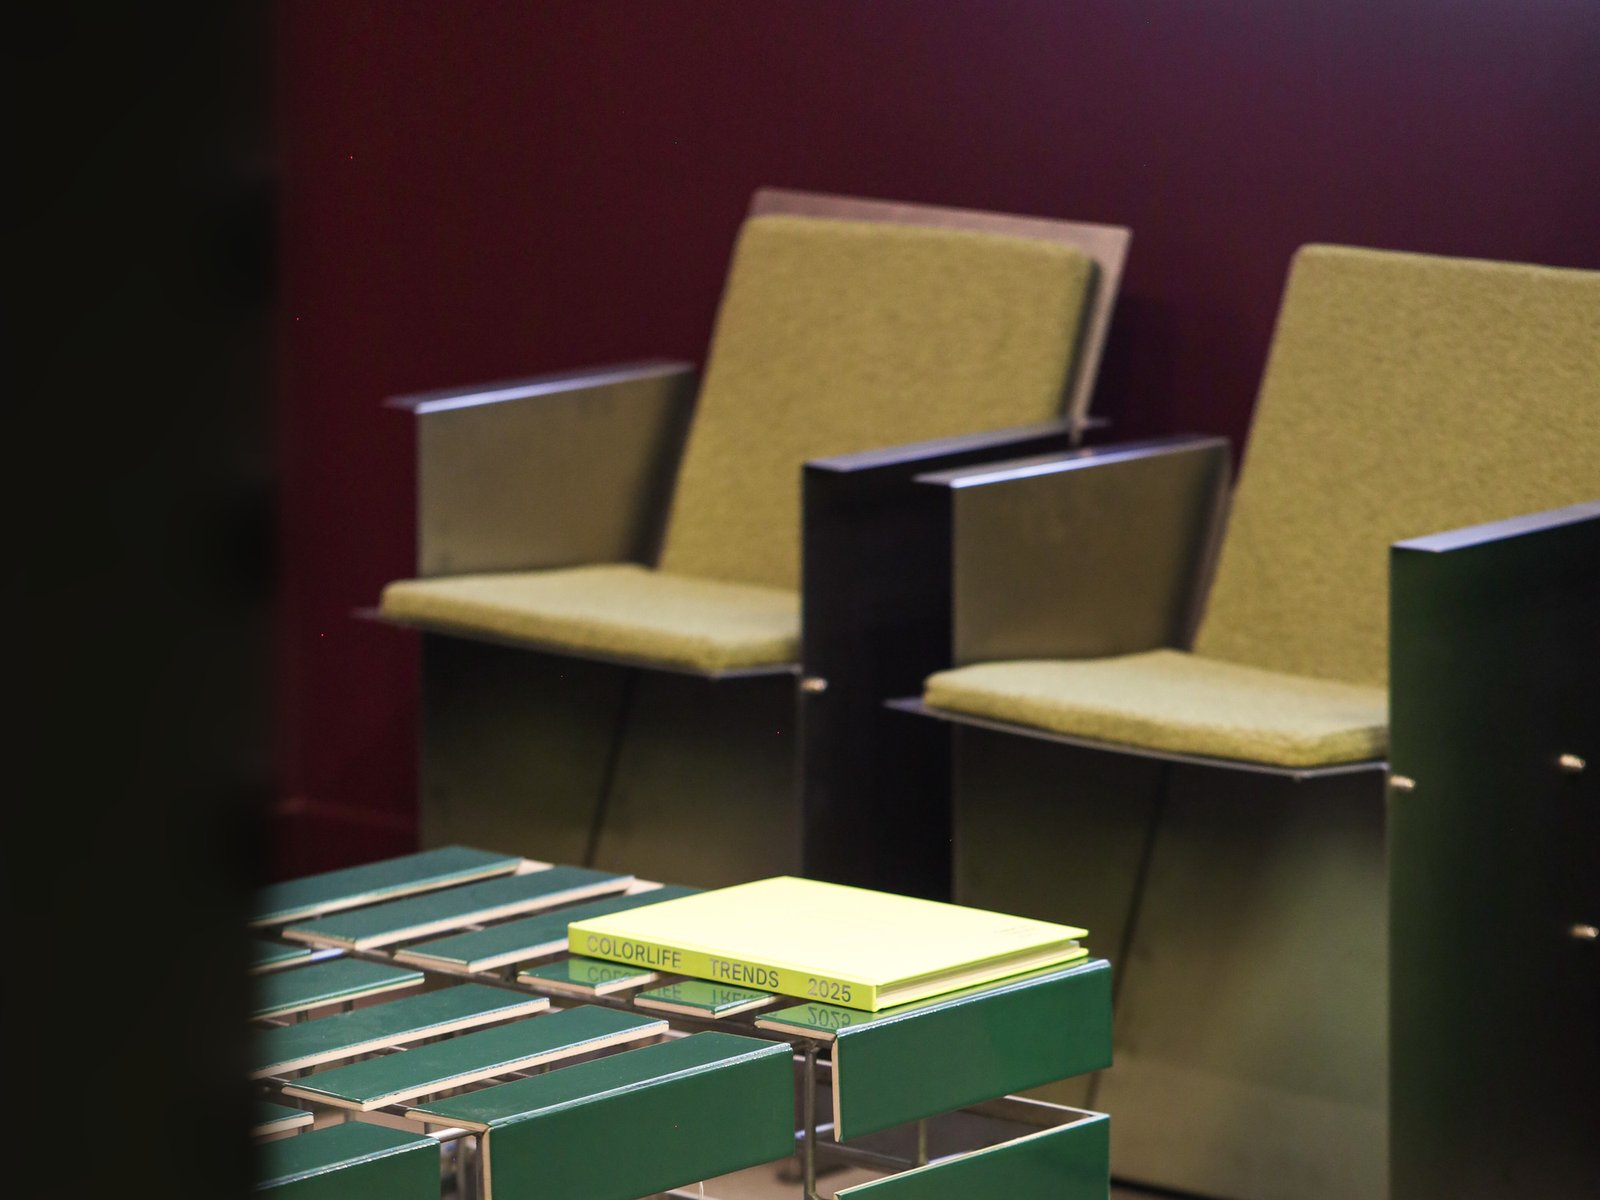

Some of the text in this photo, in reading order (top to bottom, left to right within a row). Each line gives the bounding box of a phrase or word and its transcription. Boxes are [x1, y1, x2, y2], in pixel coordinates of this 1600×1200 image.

[587, 935, 852, 1002] COLORLIFE TRENDS 2025
